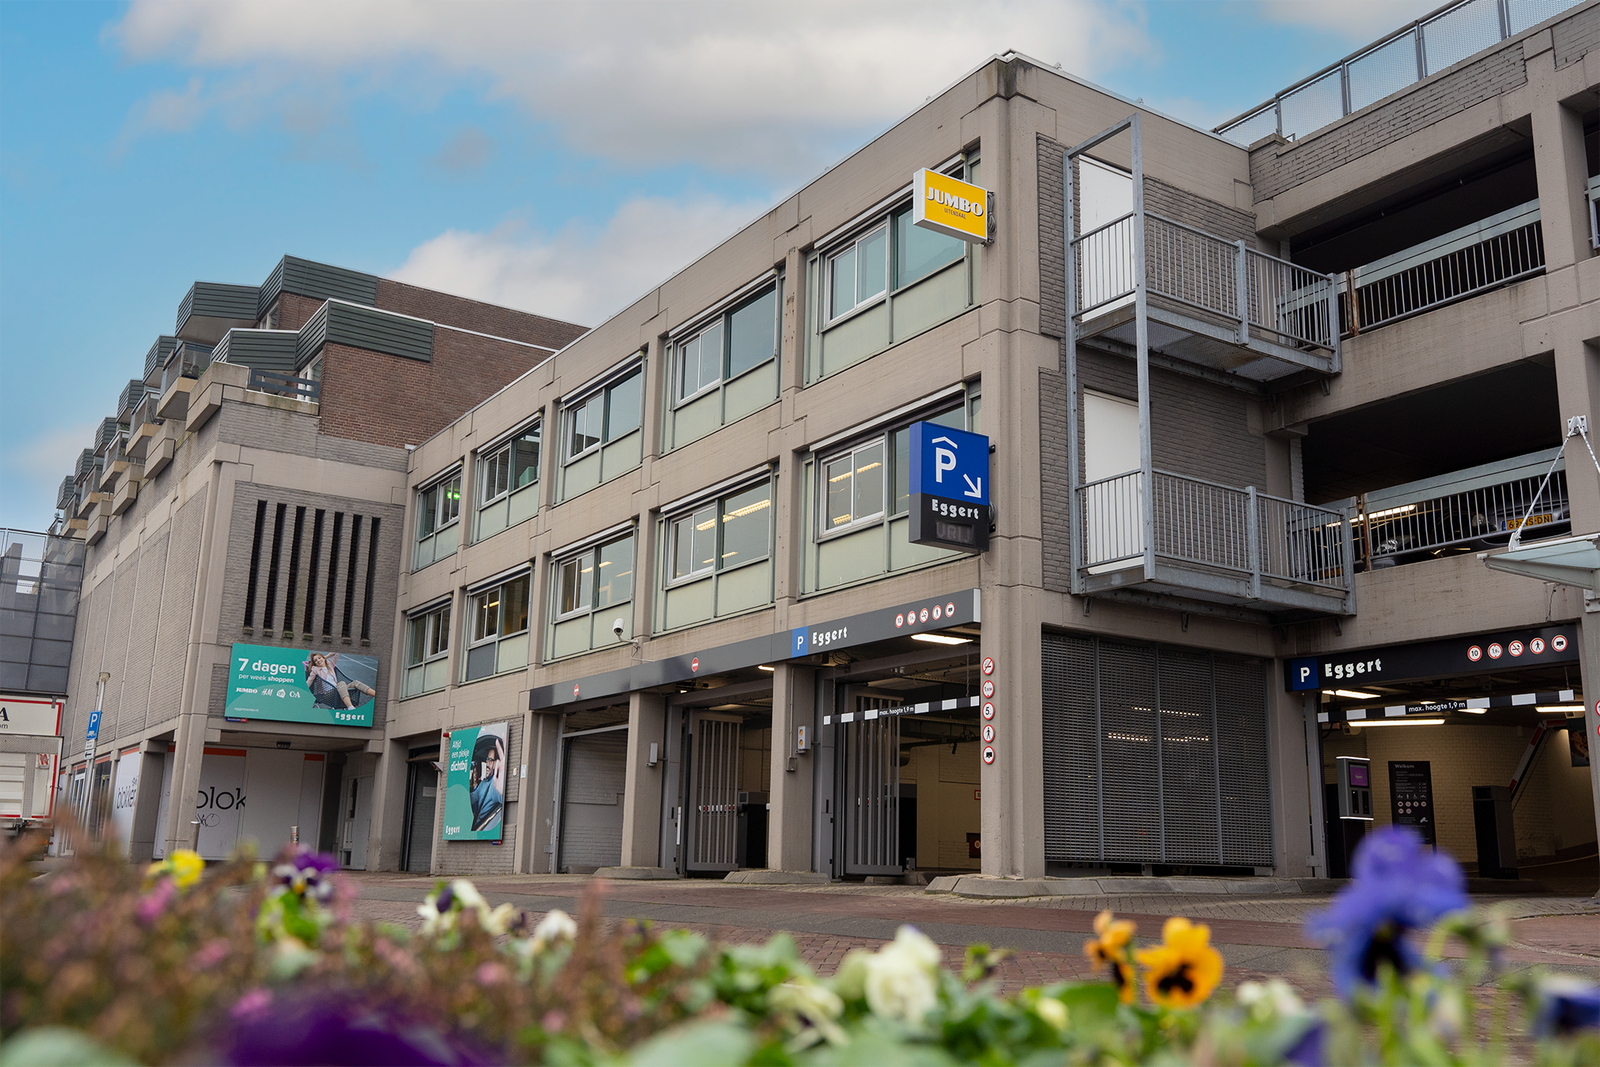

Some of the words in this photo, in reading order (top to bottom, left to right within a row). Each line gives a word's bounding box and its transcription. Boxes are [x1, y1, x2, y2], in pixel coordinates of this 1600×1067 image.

[926, 187, 984, 217] JUMBO
[936, 447, 957, 483] P
[932, 499, 979, 520] Eggert
[797, 636, 804, 650] P
[812, 627, 848, 647] Eggert
[238, 658, 249, 671] 7
[252, 660, 297, 675] dagen
[1300, 667, 1310, 683] P
[1325, 658, 1382, 680] Eggert
[267, 675, 295, 684] shoppen
[1425, 704, 1447, 712] hoogte
[1448, 701, 1458, 709] 1,9
[90, 713, 98, 727] P
[335, 712, 365, 721] Eggert
[450, 759, 468, 773] dichtbij
[445, 825, 460, 836] Eggert
